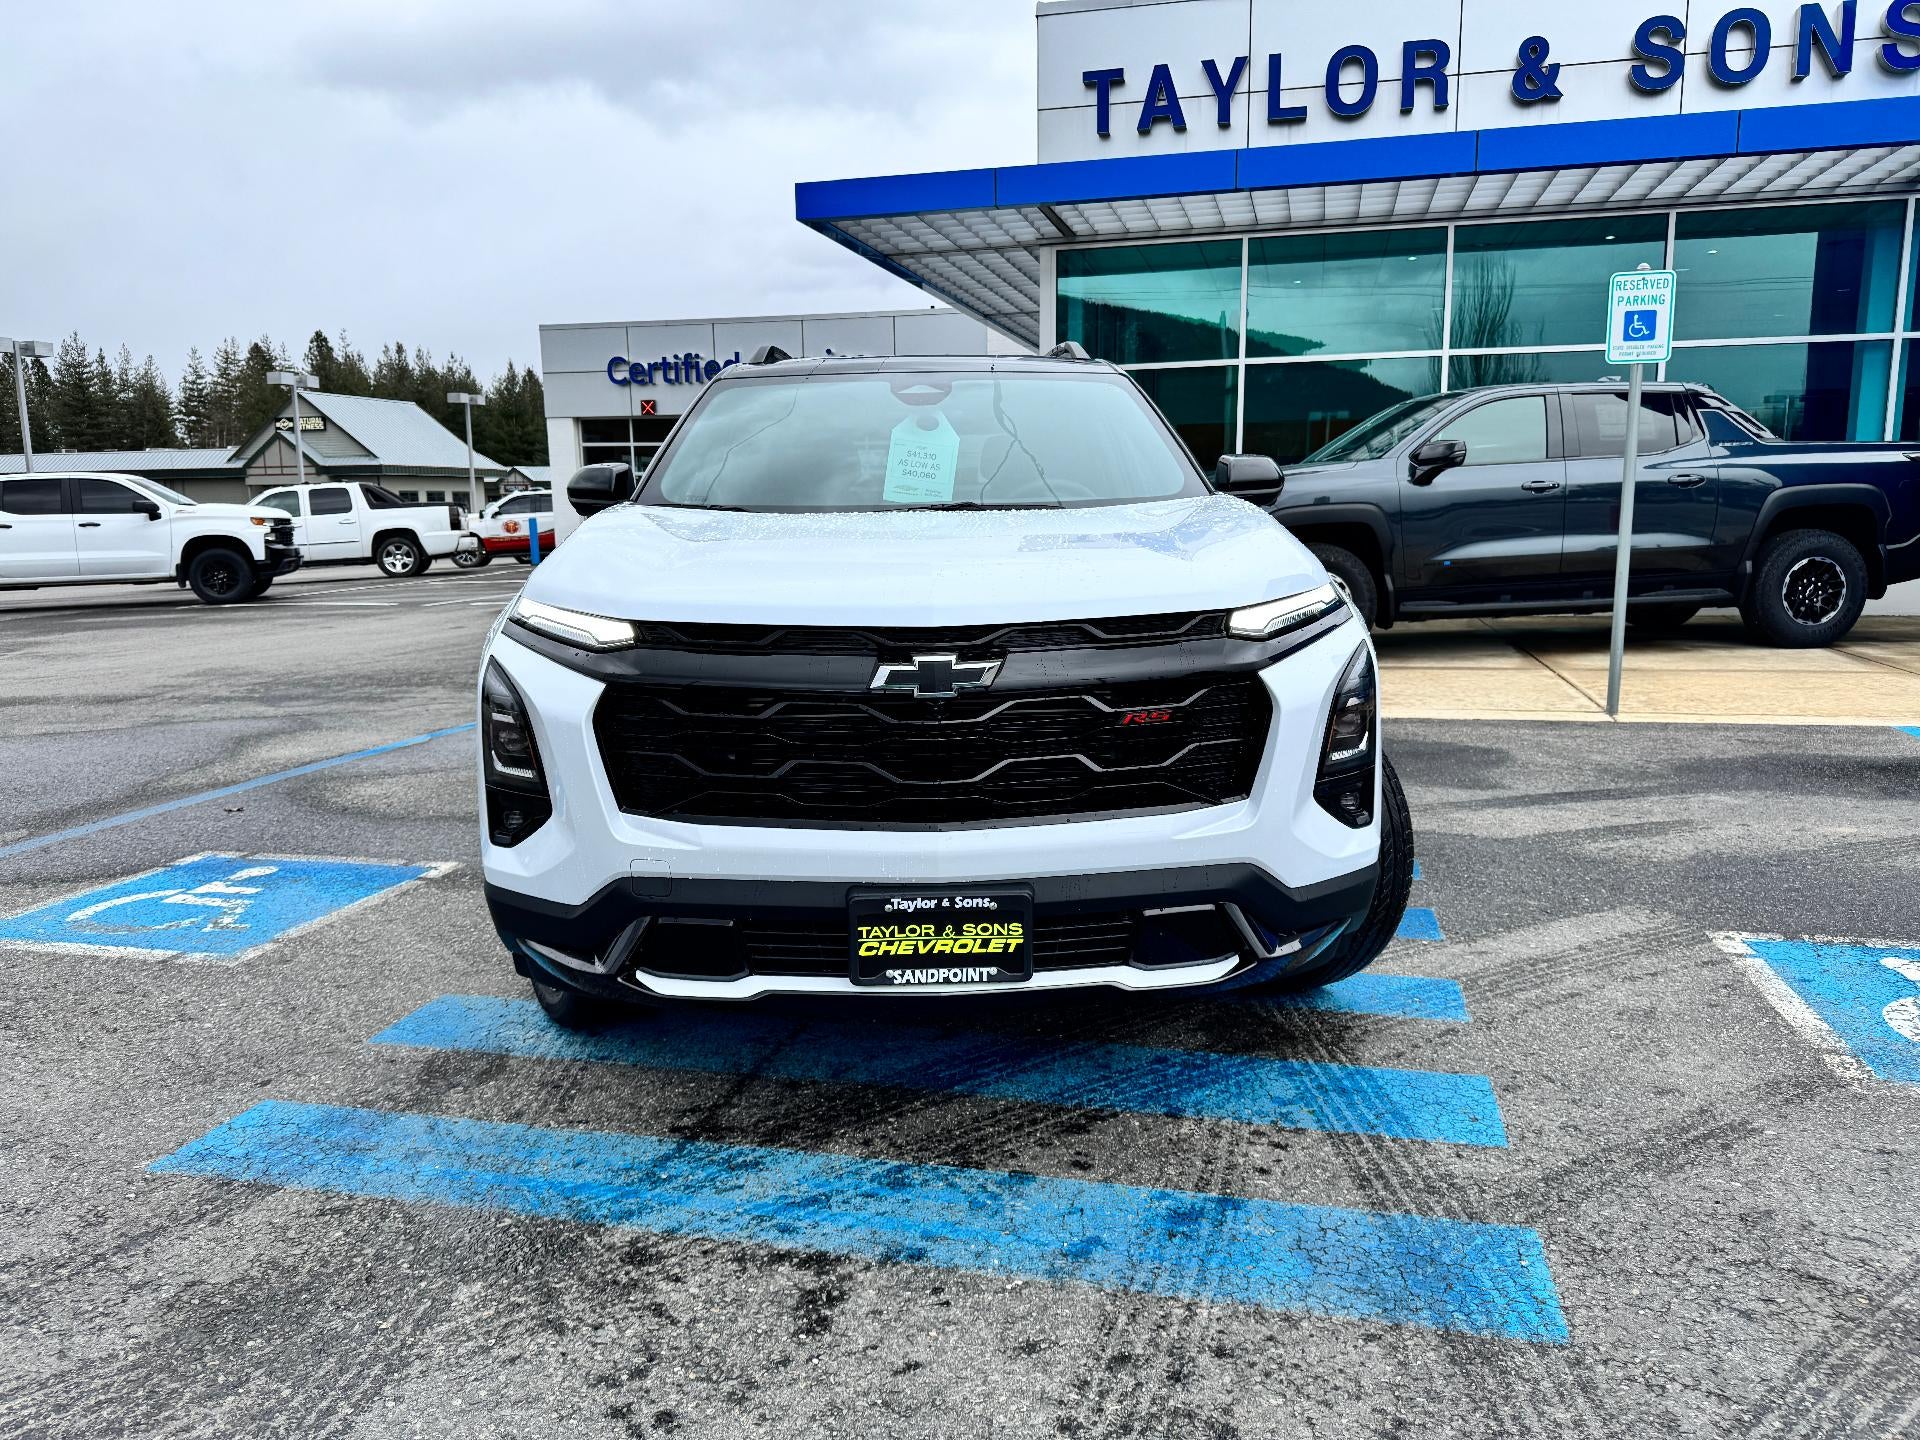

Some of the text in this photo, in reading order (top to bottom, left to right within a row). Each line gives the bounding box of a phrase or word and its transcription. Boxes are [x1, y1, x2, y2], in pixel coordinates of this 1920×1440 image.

[1083, 0, 1920, 137] TAYLOR & SONS
[1616, 278, 1669, 291] RESERVED
[1617, 294, 1666, 307] PARKING
[898, 458, 941, 471] AS LOW AS
[1121, 709, 1172, 725] RS
[890, 896, 991, 912] Taylor & Sons
[858, 922, 1024, 938] TAYLOR & SONS
[858, 938, 1024, 957] CHEVROLET
[892, 967, 991, 985] SANDPOINT
